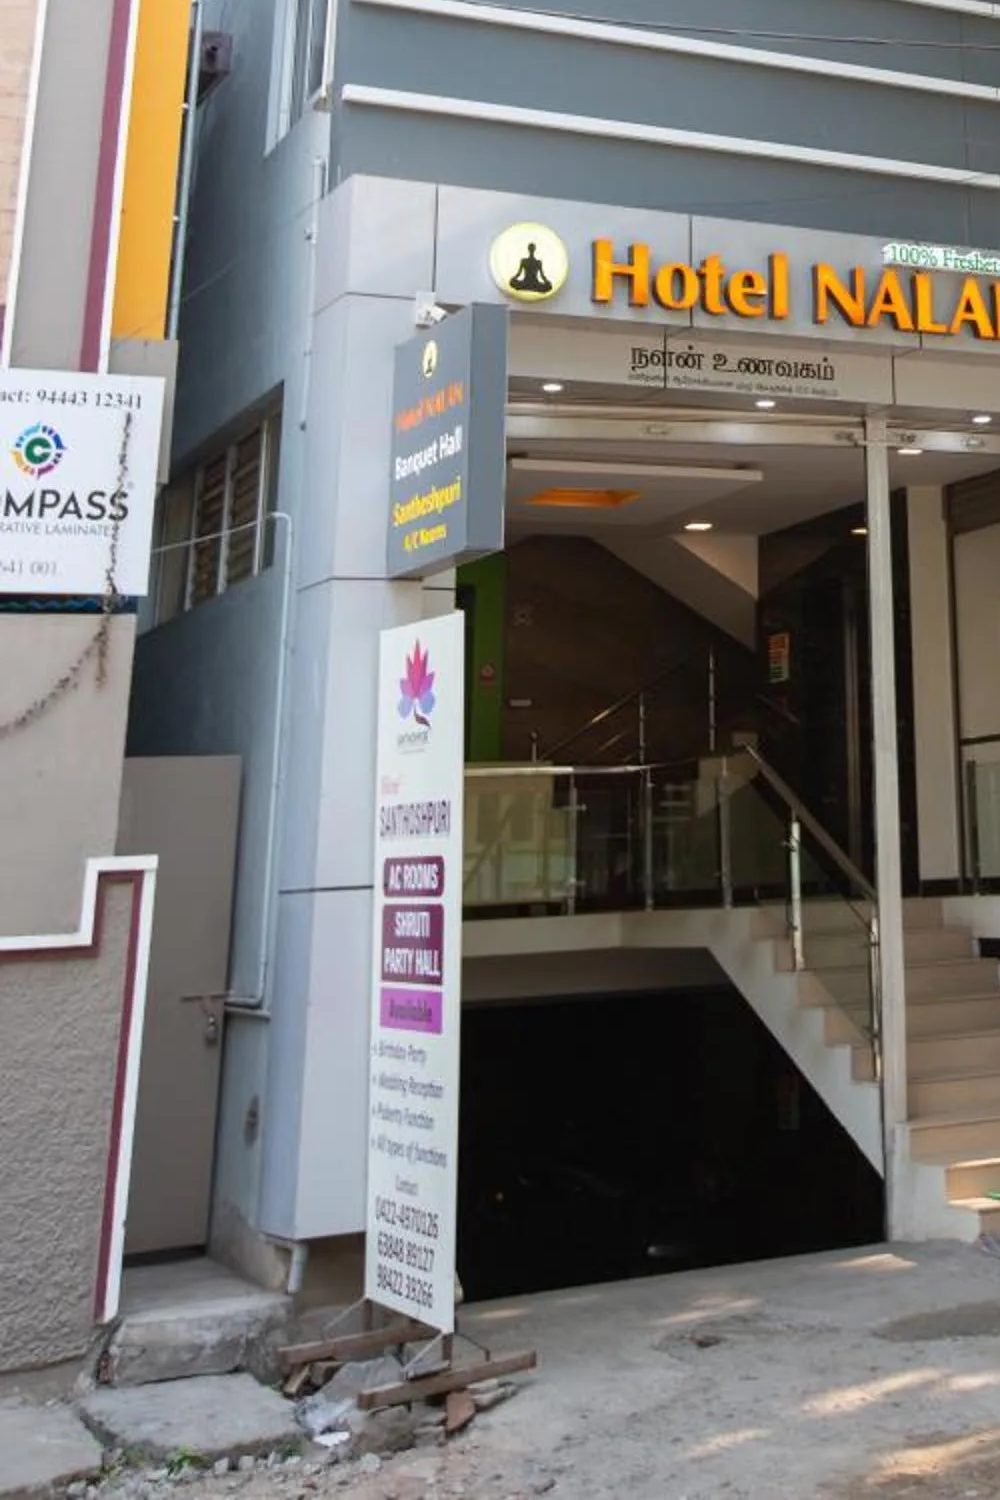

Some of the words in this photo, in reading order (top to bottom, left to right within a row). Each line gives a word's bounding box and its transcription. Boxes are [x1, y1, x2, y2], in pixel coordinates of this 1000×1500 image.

[890, 244, 937, 267] 100%
[591, 238, 790, 319] Hotel
[37, 389, 87, 405] 94443
[95, 392, 142, 410] 12341
[395, 440, 438, 481] Banquet
[439, 424, 463, 458] Hall
[0, 487, 129, 521] MPASS
[0, 559, 23, 576] 41
[388, 864, 403, 890] AC
[404, 863, 440, 890] ROOMS
[384, 947, 414, 975] PARTY
[415, 949, 441, 977] HALL
